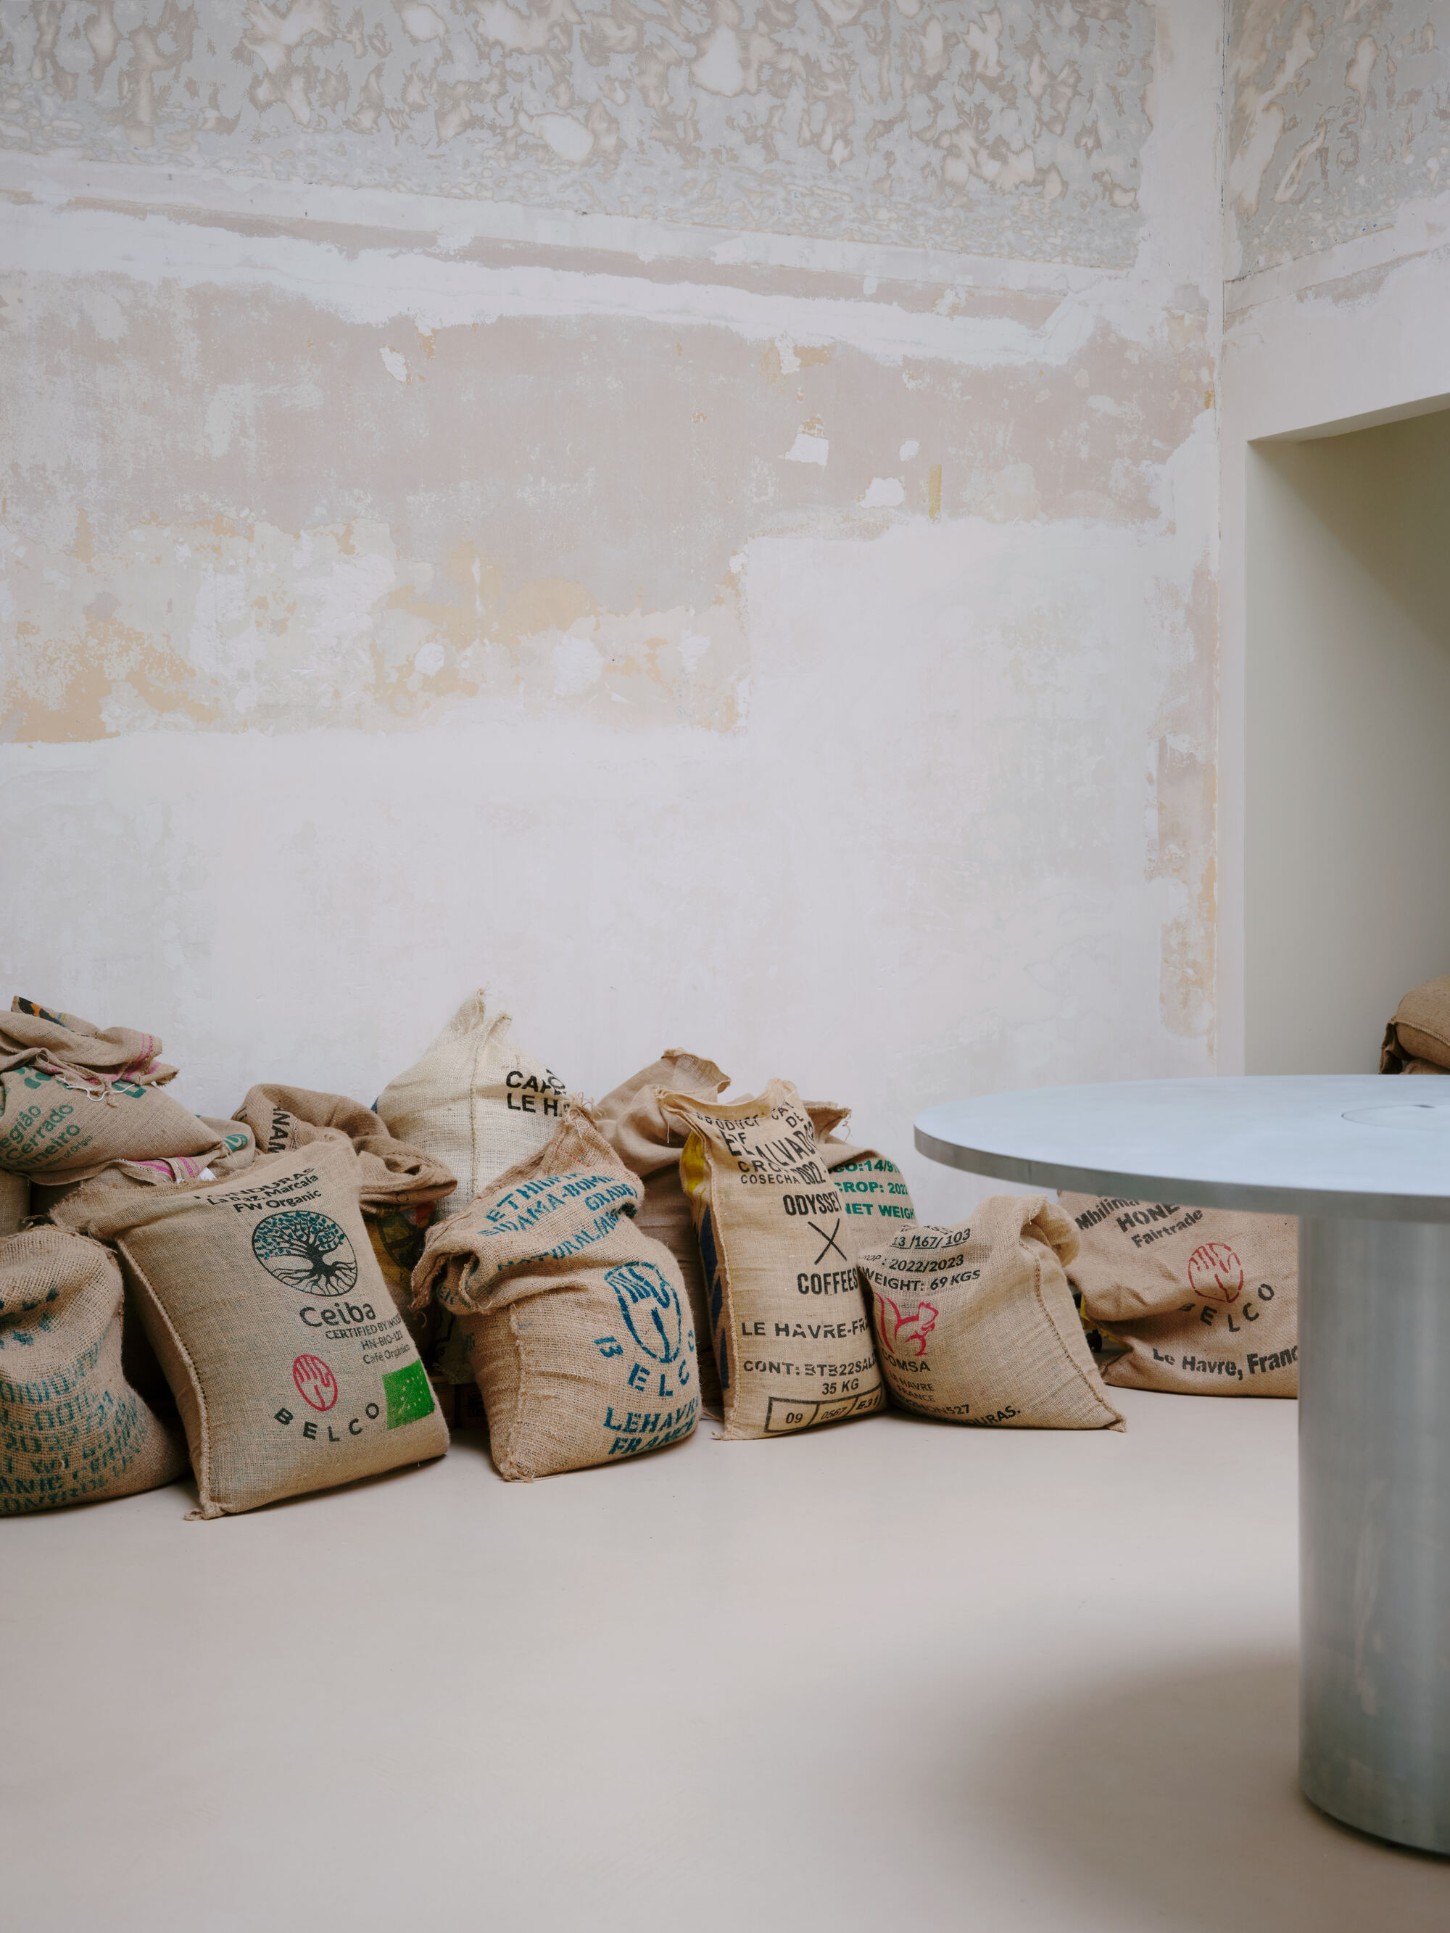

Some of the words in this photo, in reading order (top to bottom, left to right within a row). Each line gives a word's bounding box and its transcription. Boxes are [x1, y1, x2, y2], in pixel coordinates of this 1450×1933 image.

[506, 1093, 536, 1113] LE
[6, 1104, 74, 1161] Cerrado
[263, 1174, 319, 1198] Marcala
[741, 1174, 800, 1185] COSECHA
[232, 1201, 263, 1213] FW
[265, 1189, 322, 1209] Organic
[782, 1192, 842, 1216] ODYSSEY
[1131, 1208, 1204, 1248] Fairtrade
[797, 1266, 859, 1295] COFFEES
[929, 1276, 949, 1292] 69
[950, 1269, 982, 1287] KGS
[299, 1301, 377, 1328] Ceiba
[325, 1324, 378, 1341] CERTIFIED
[741, 1322, 766, 1336] LE
[1152, 1347, 1176, 1366] Le
[1181, 1355, 1244, 1381] Havre,
[821, 1382, 837, 1396] 35
[841, 1378, 859, 1392] KG
[273, 1402, 381, 1442] BELCO
[785, 1411, 804, 1424] 09
